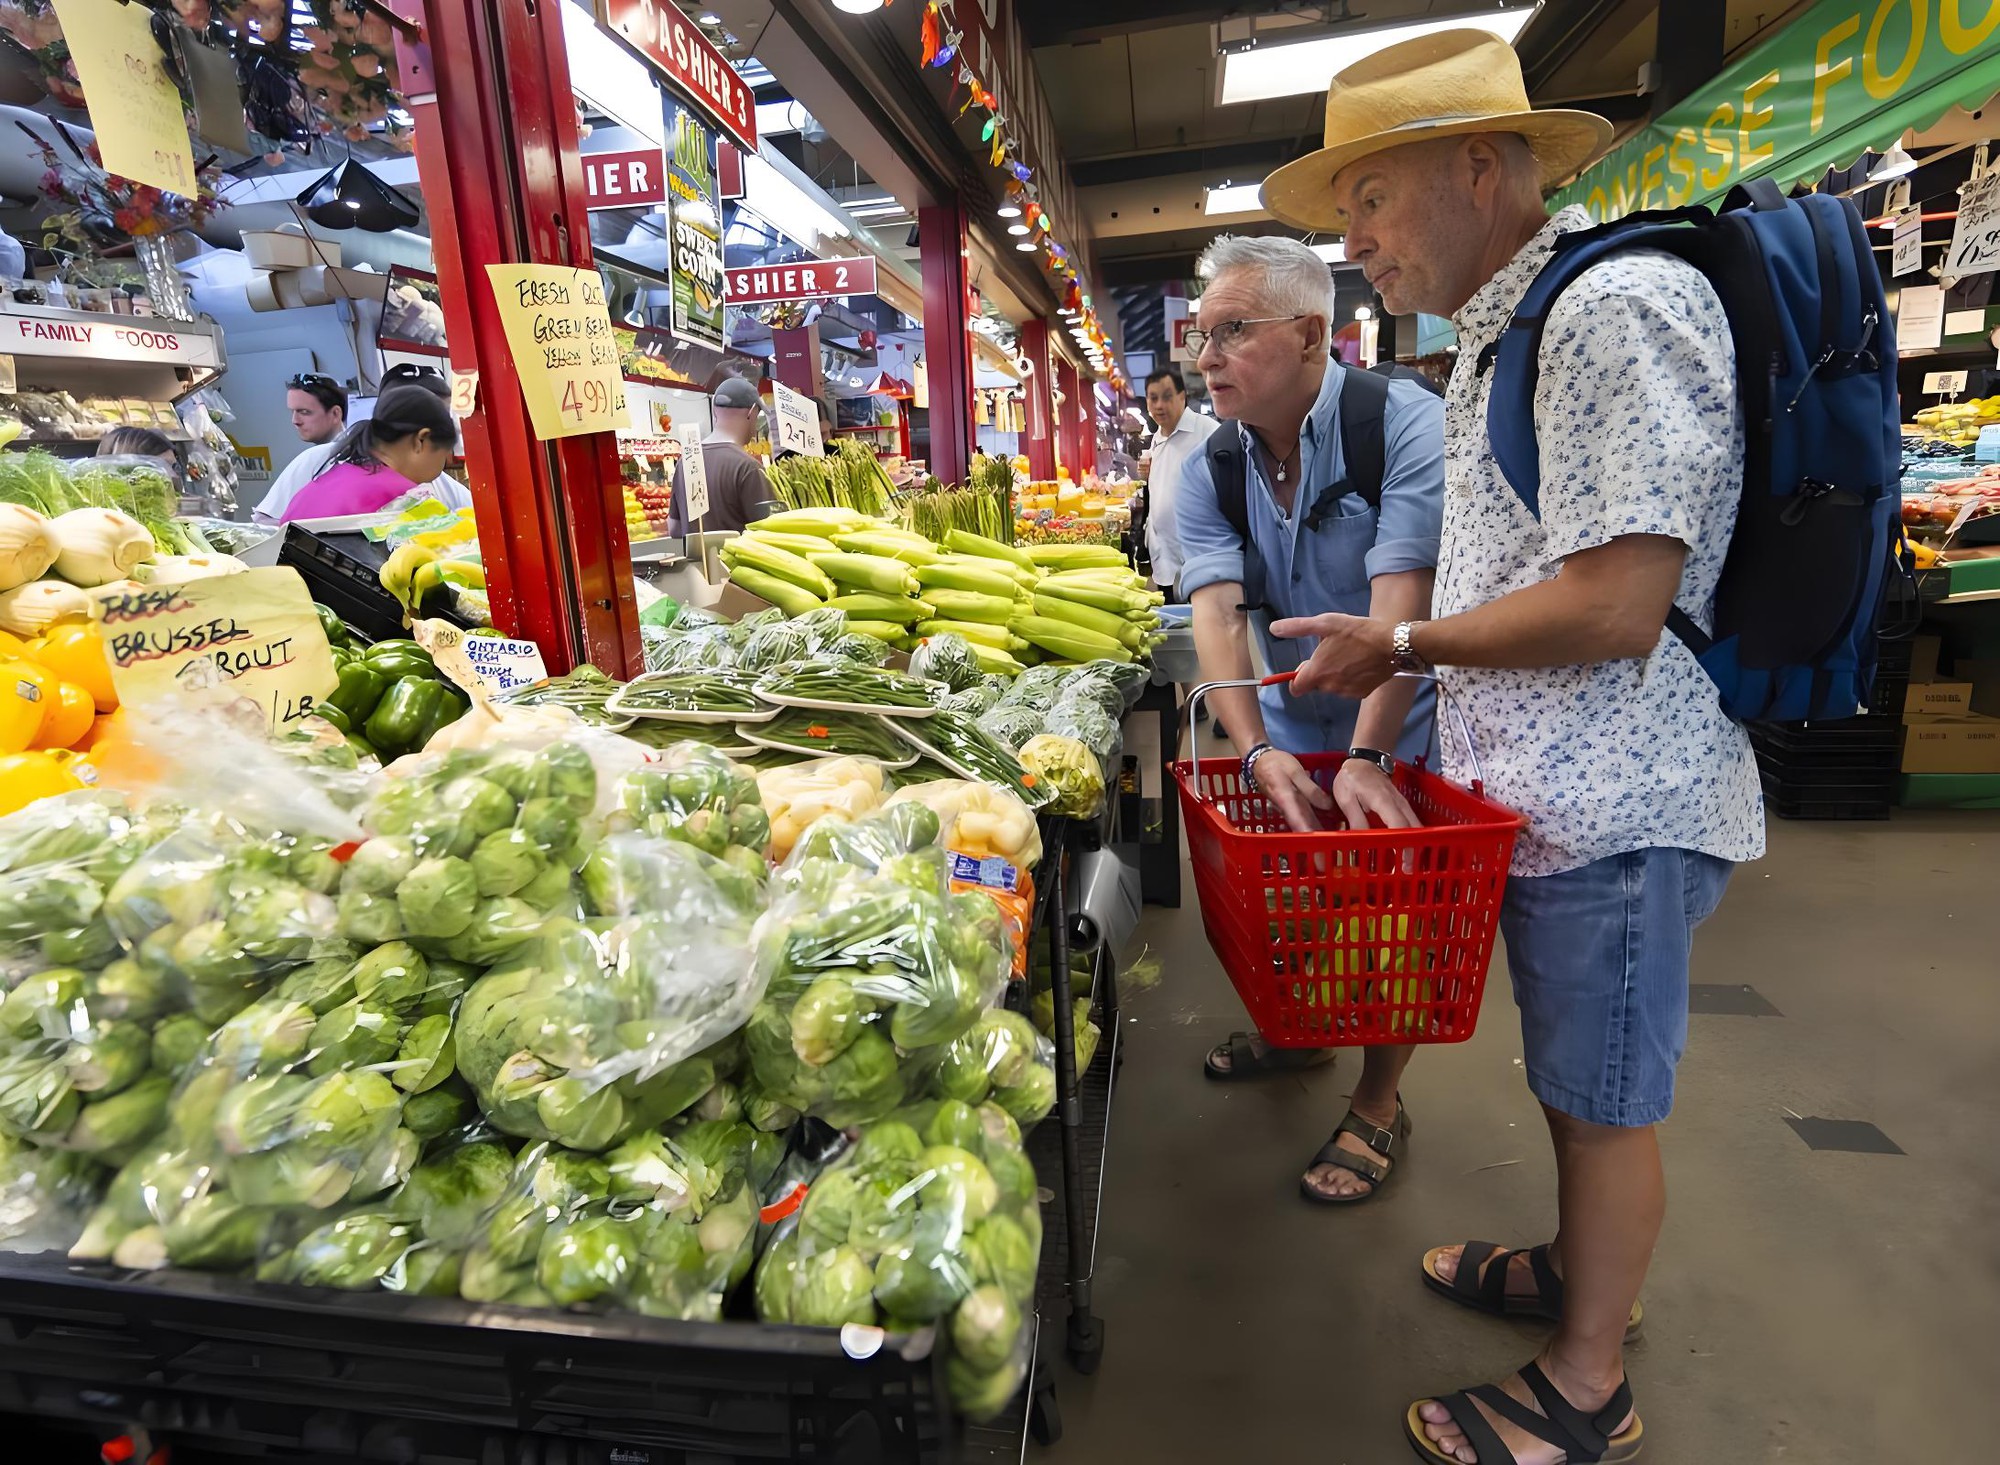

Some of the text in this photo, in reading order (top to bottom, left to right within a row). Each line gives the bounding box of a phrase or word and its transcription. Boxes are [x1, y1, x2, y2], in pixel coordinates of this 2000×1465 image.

[640, 0, 747, 128] CASHIER 3
[676, 221, 717, 257] SWEET
[678, 246, 717, 285] CORN
[835, 266, 849, 289] 2
[18, 320, 92, 343] FAMILY
[533, 314, 582, 344] GREEN
[455, 377, 472, 410] 3
[112, 618, 249, 662] BRUSSEL
[467, 640, 534, 656] ONTARIO
[176, 637, 293, 680] ROUT
